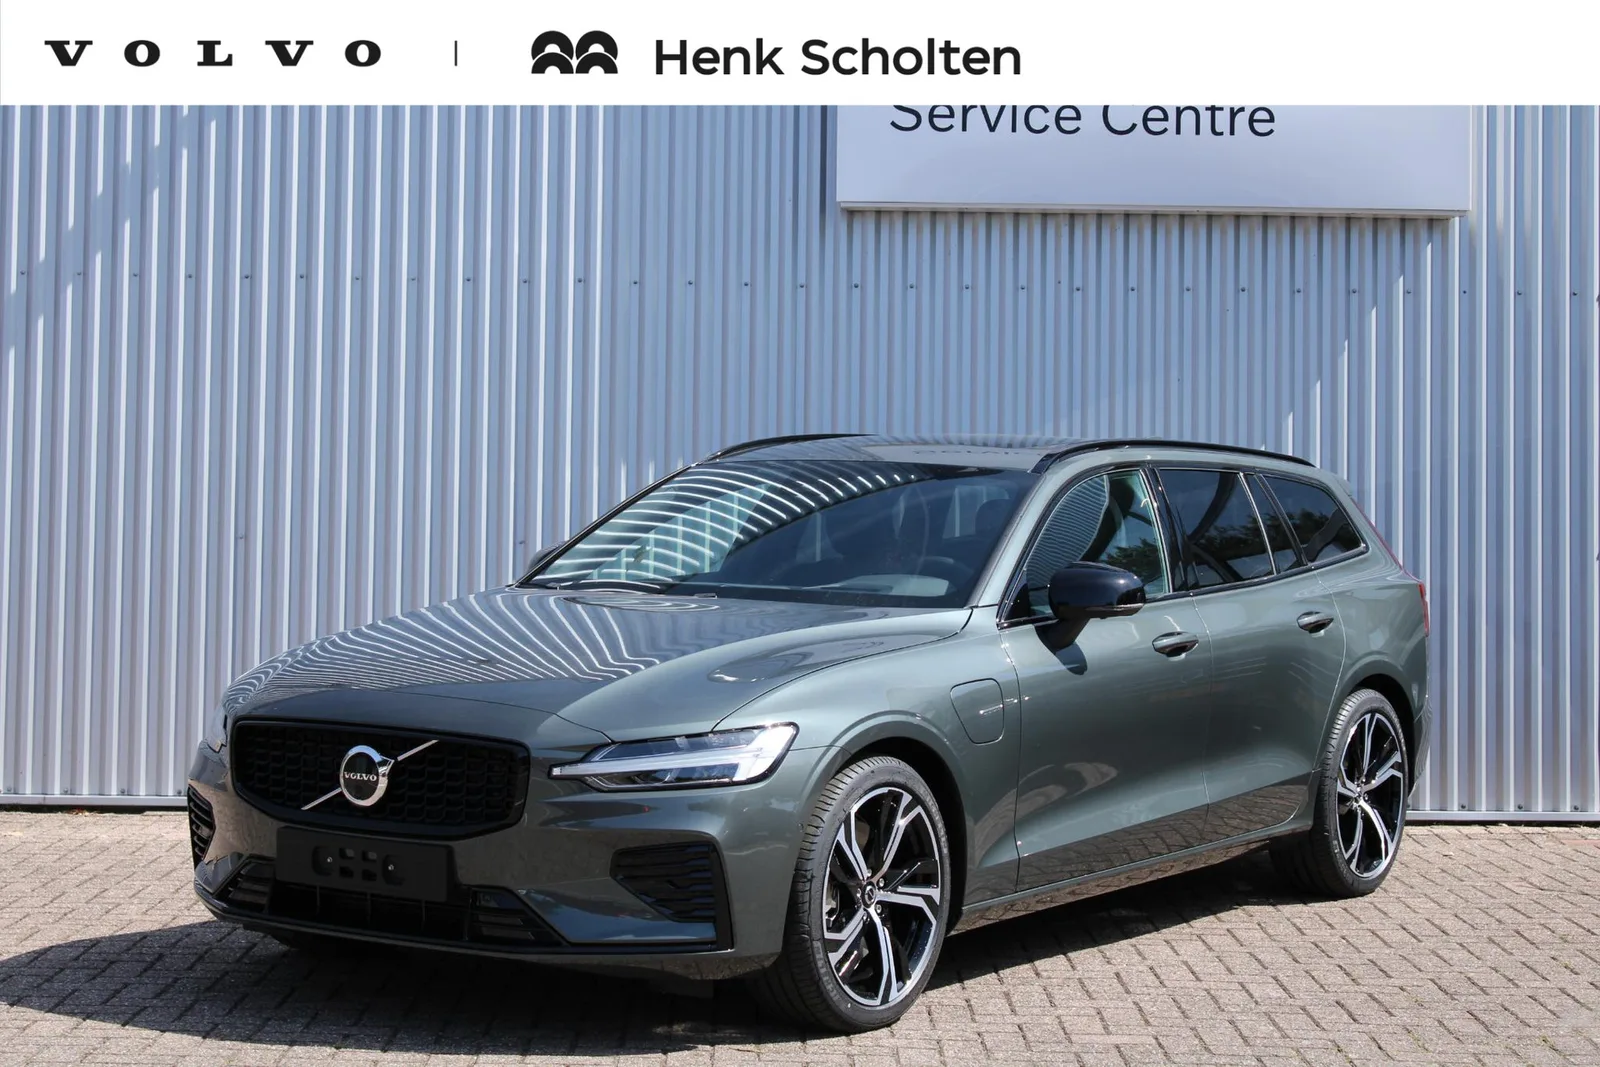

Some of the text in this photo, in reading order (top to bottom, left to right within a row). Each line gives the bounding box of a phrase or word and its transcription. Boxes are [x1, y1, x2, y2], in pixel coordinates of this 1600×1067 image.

[890, 105, 1275, 137] Service Centre
[344, 772, 377, 781] VOLVO
